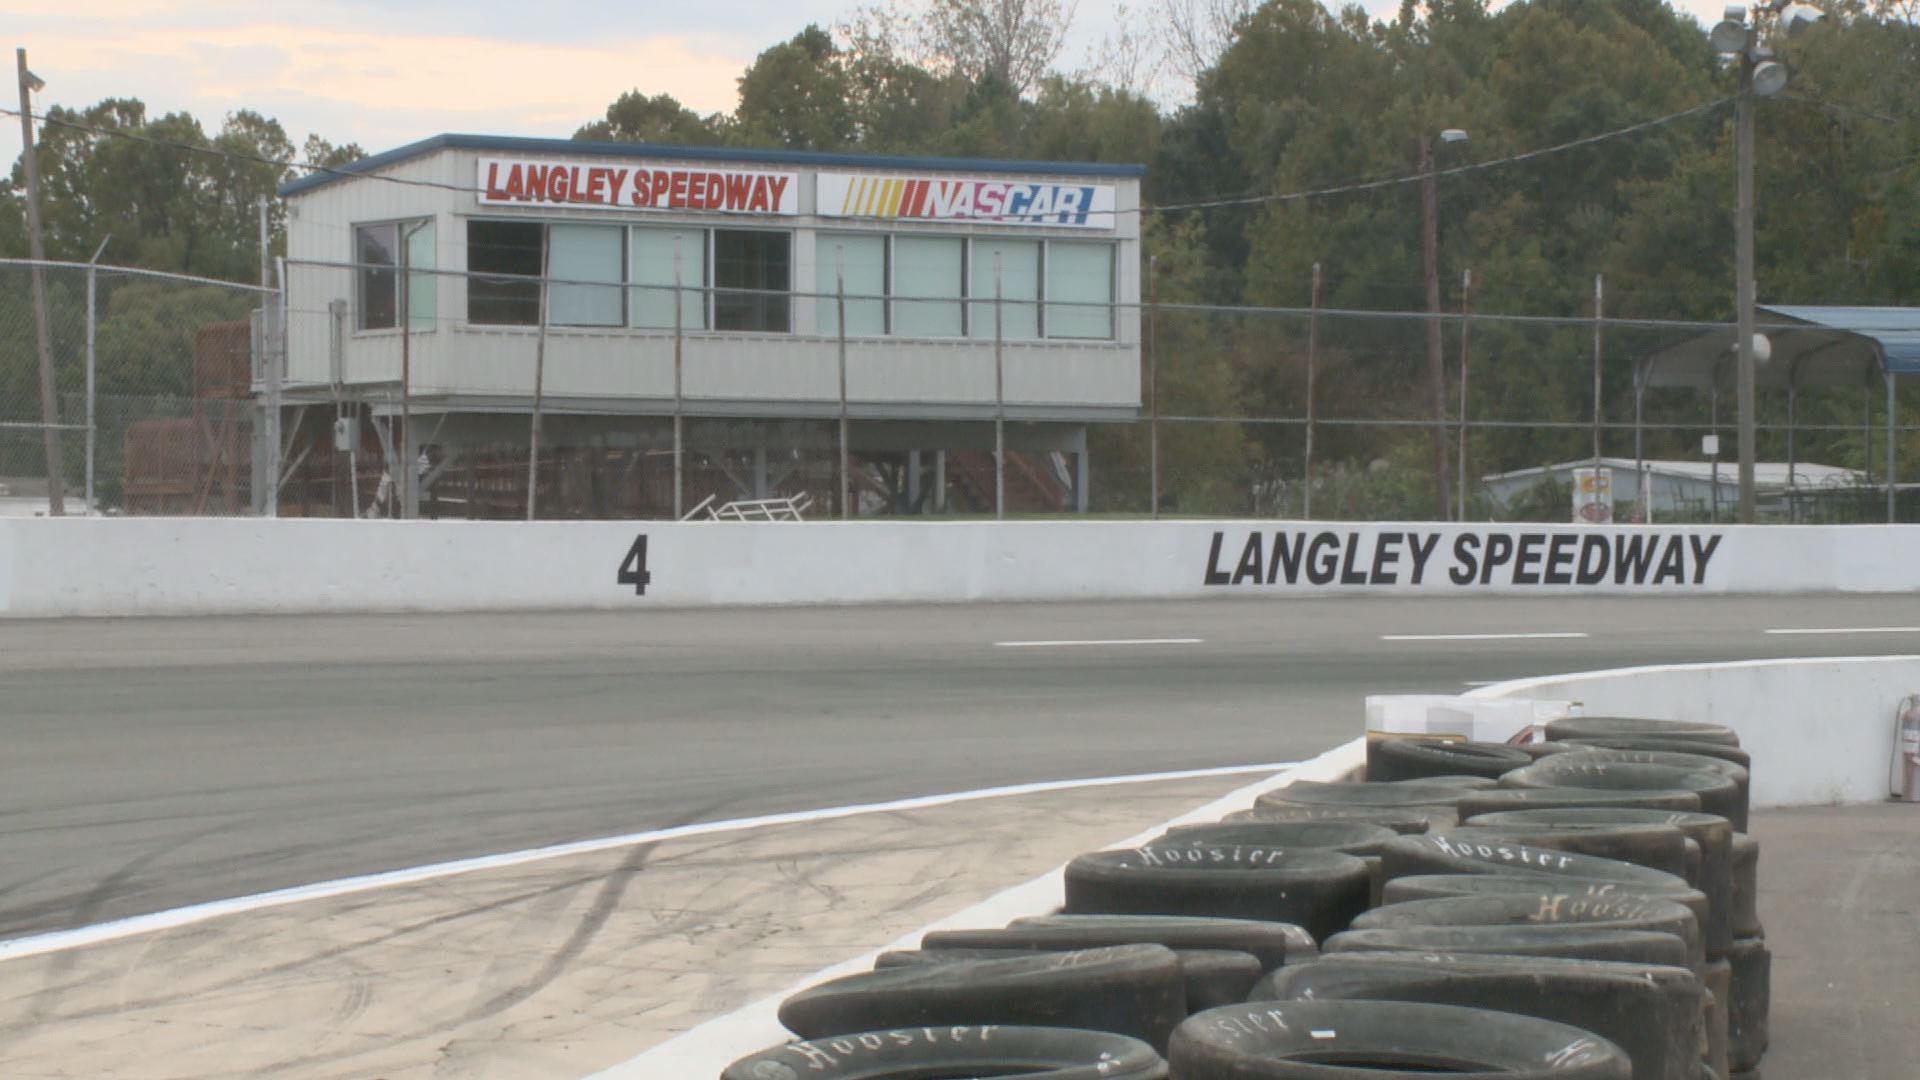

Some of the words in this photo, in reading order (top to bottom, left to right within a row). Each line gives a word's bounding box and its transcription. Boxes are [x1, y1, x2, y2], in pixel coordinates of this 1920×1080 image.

[486, 162, 629, 206] LANGLEY
[631, 169, 790, 213] SPEEDWAY
[921, 180, 1085, 225] NASCAR
[617, 534, 651, 596] 4
[1203, 531, 1442, 586] LANGLEY
[1448, 532, 1723, 586] SPEEDWAY
[1431, 835, 1574, 869] Hoosier
[786, 1024, 1000, 1071] Hoosier
